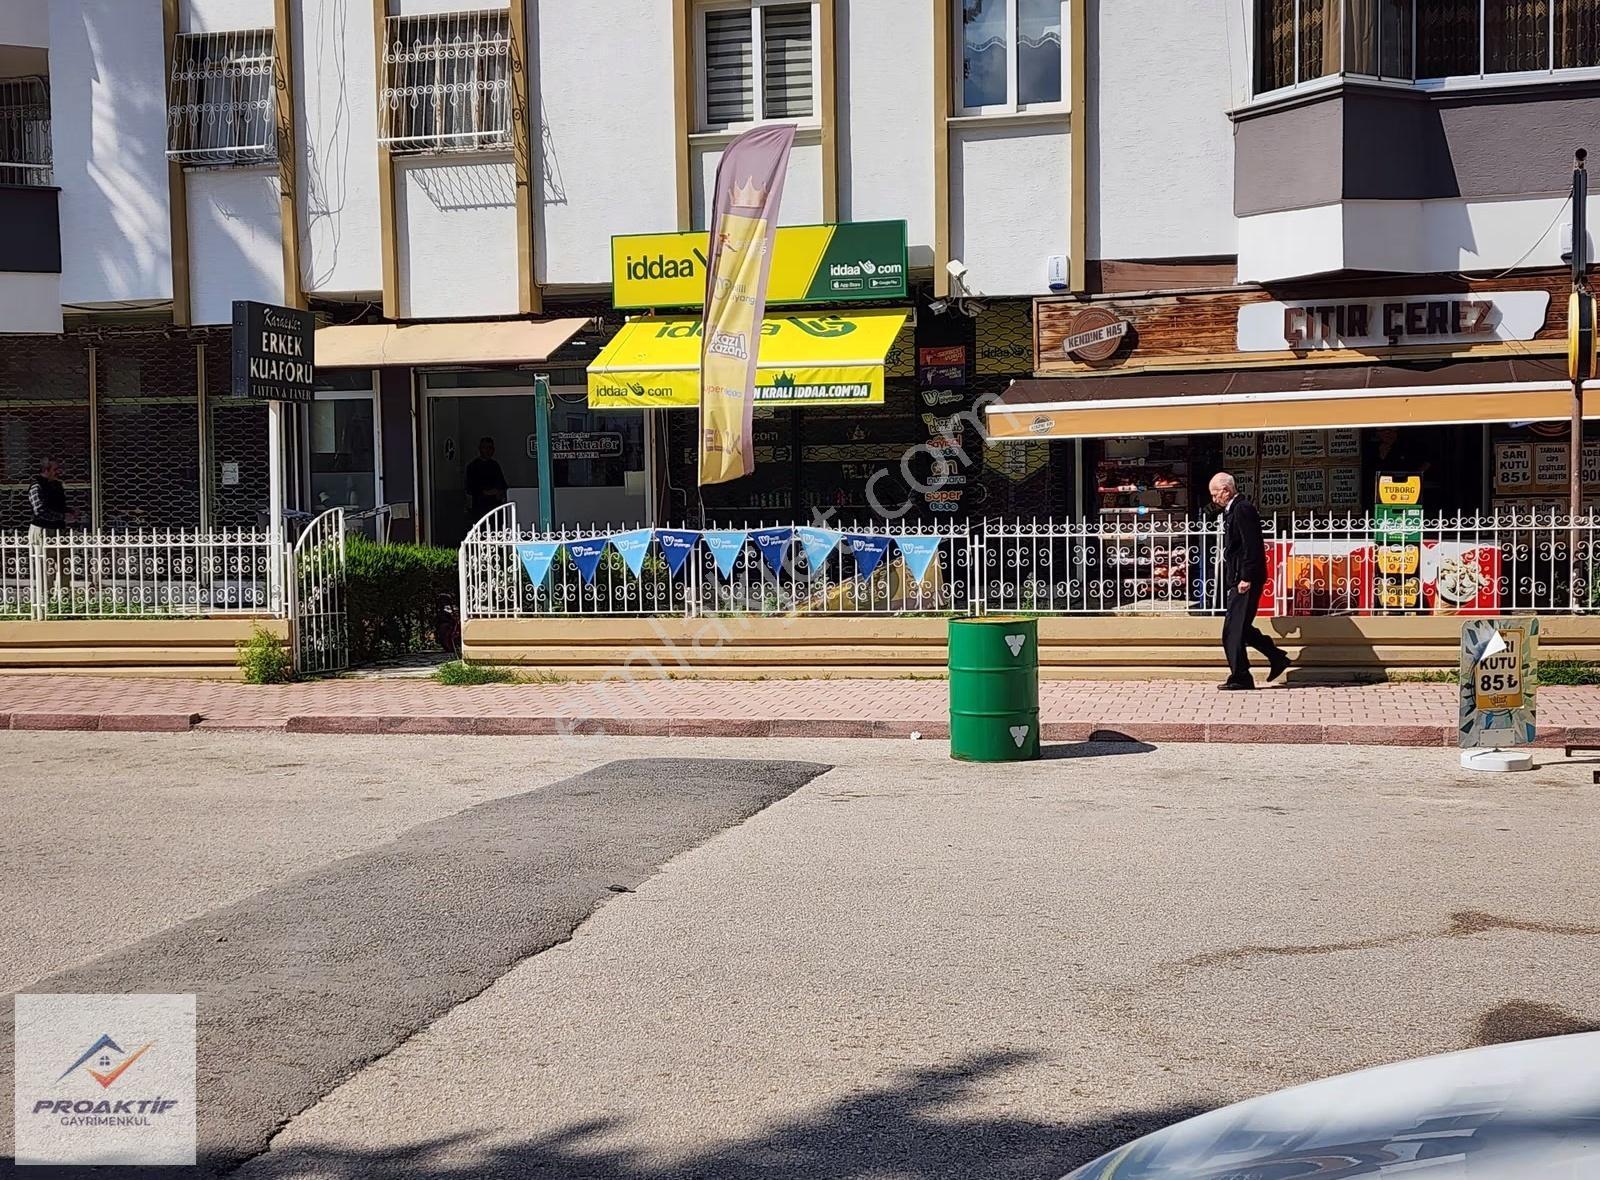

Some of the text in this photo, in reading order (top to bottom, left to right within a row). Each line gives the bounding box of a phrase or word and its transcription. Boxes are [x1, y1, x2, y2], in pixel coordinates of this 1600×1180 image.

[626, 254, 694, 280] iddaa
[830, 264, 902, 276] iddaa com
[1284, 300, 1495, 349] ÇITIR ÇEREZ
[1106, 324, 1123, 338] HAS
[262, 331, 303, 357] ERKEK
[250, 357, 313, 385] KUAFÖRÜ
[596, 385, 673, 397] iddaa com
[573, 438, 619, 450] Kuaför
[1502, 450, 1527, 459] SARI
[1500, 460, 1529, 470] KUTU
[1384, 486, 1416, 494] TUBORG
[1480, 657, 1517, 670] KUTU
